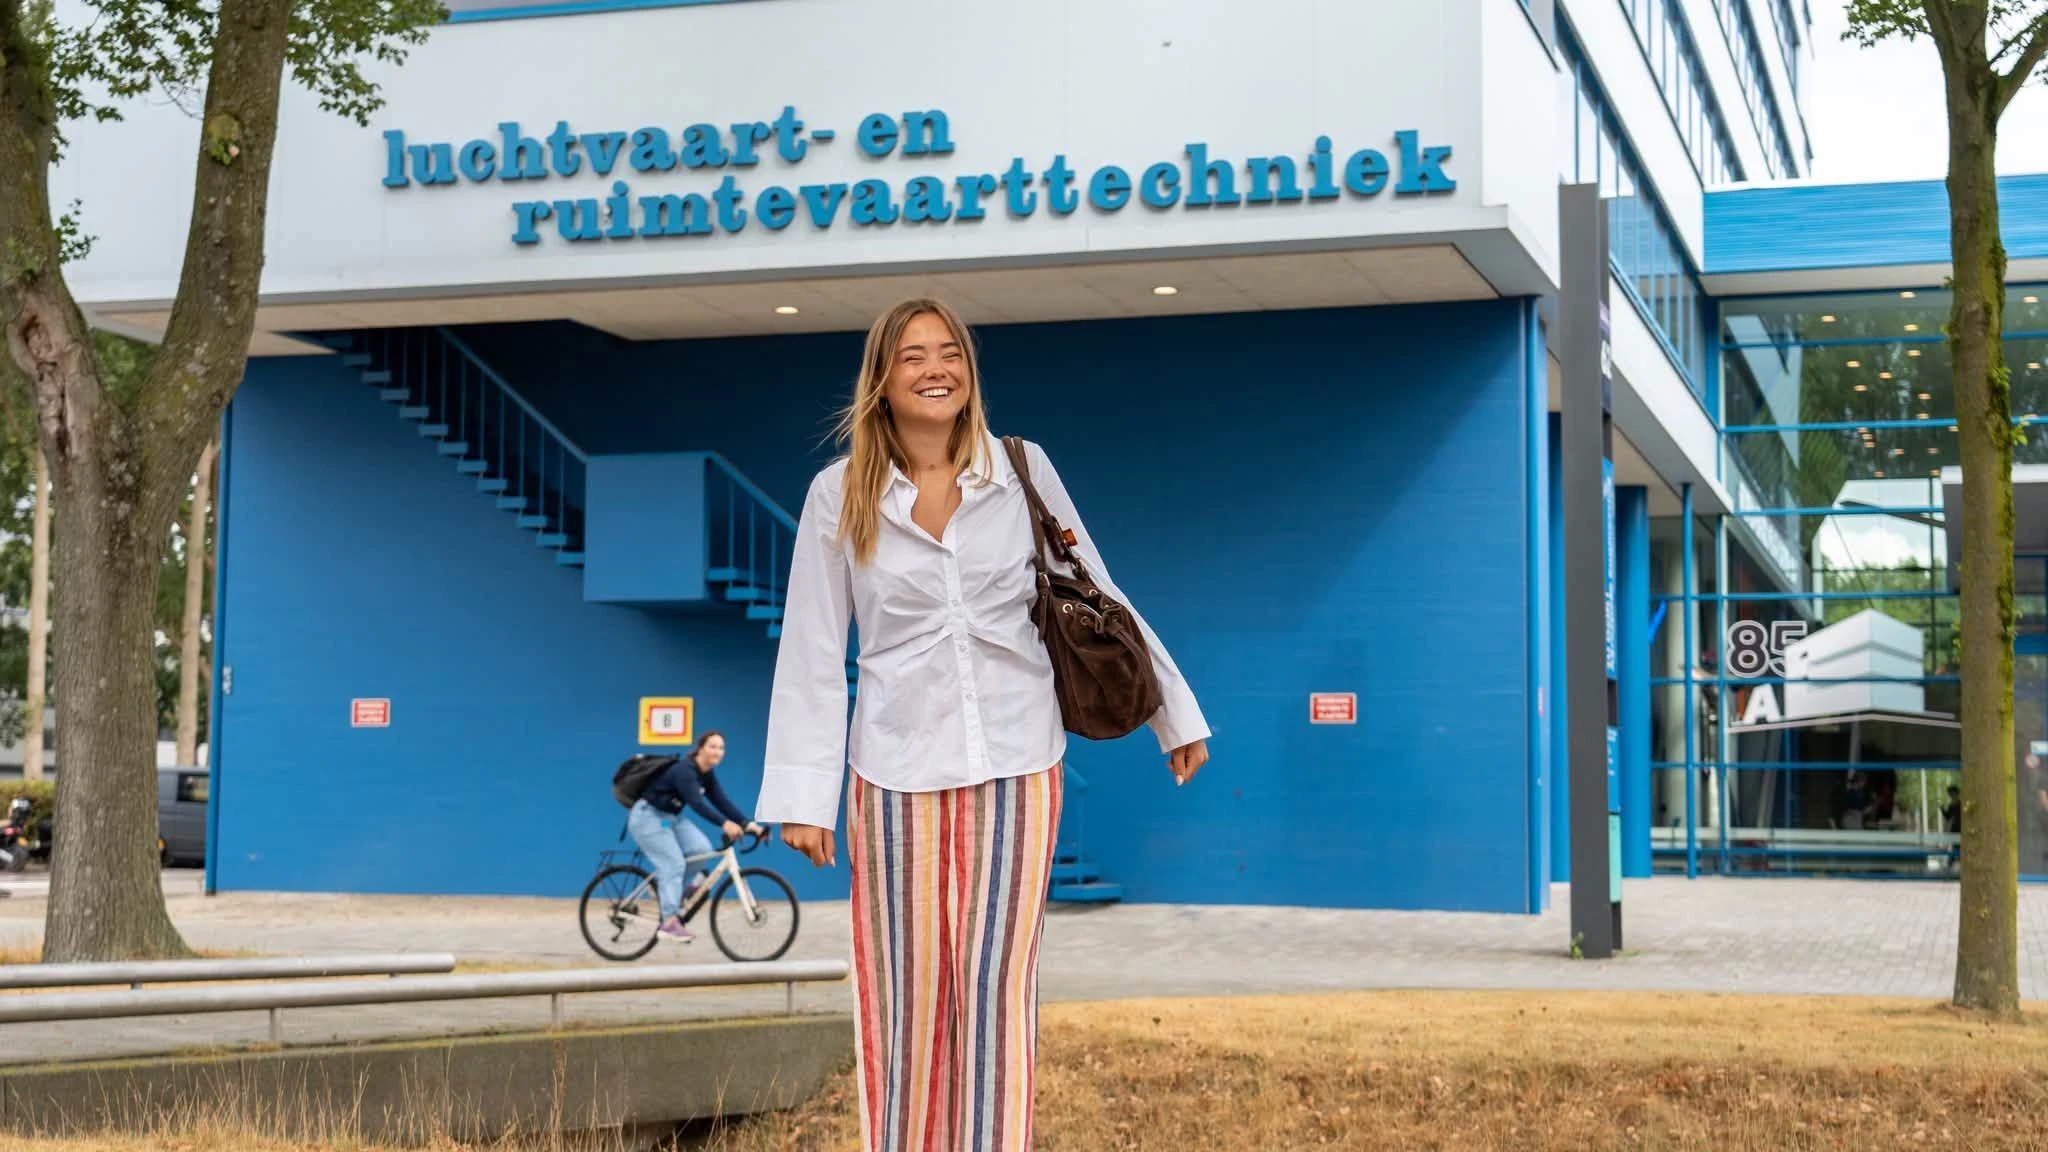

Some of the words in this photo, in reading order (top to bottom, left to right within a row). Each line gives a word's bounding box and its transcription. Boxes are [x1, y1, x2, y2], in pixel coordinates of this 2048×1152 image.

[382, 105, 836, 188] luchtvaart-
[857, 109, 955, 158] en
[511, 129, 1457, 245] ruimtevaarttechniek
[1728, 619, 1808, 678] 85
